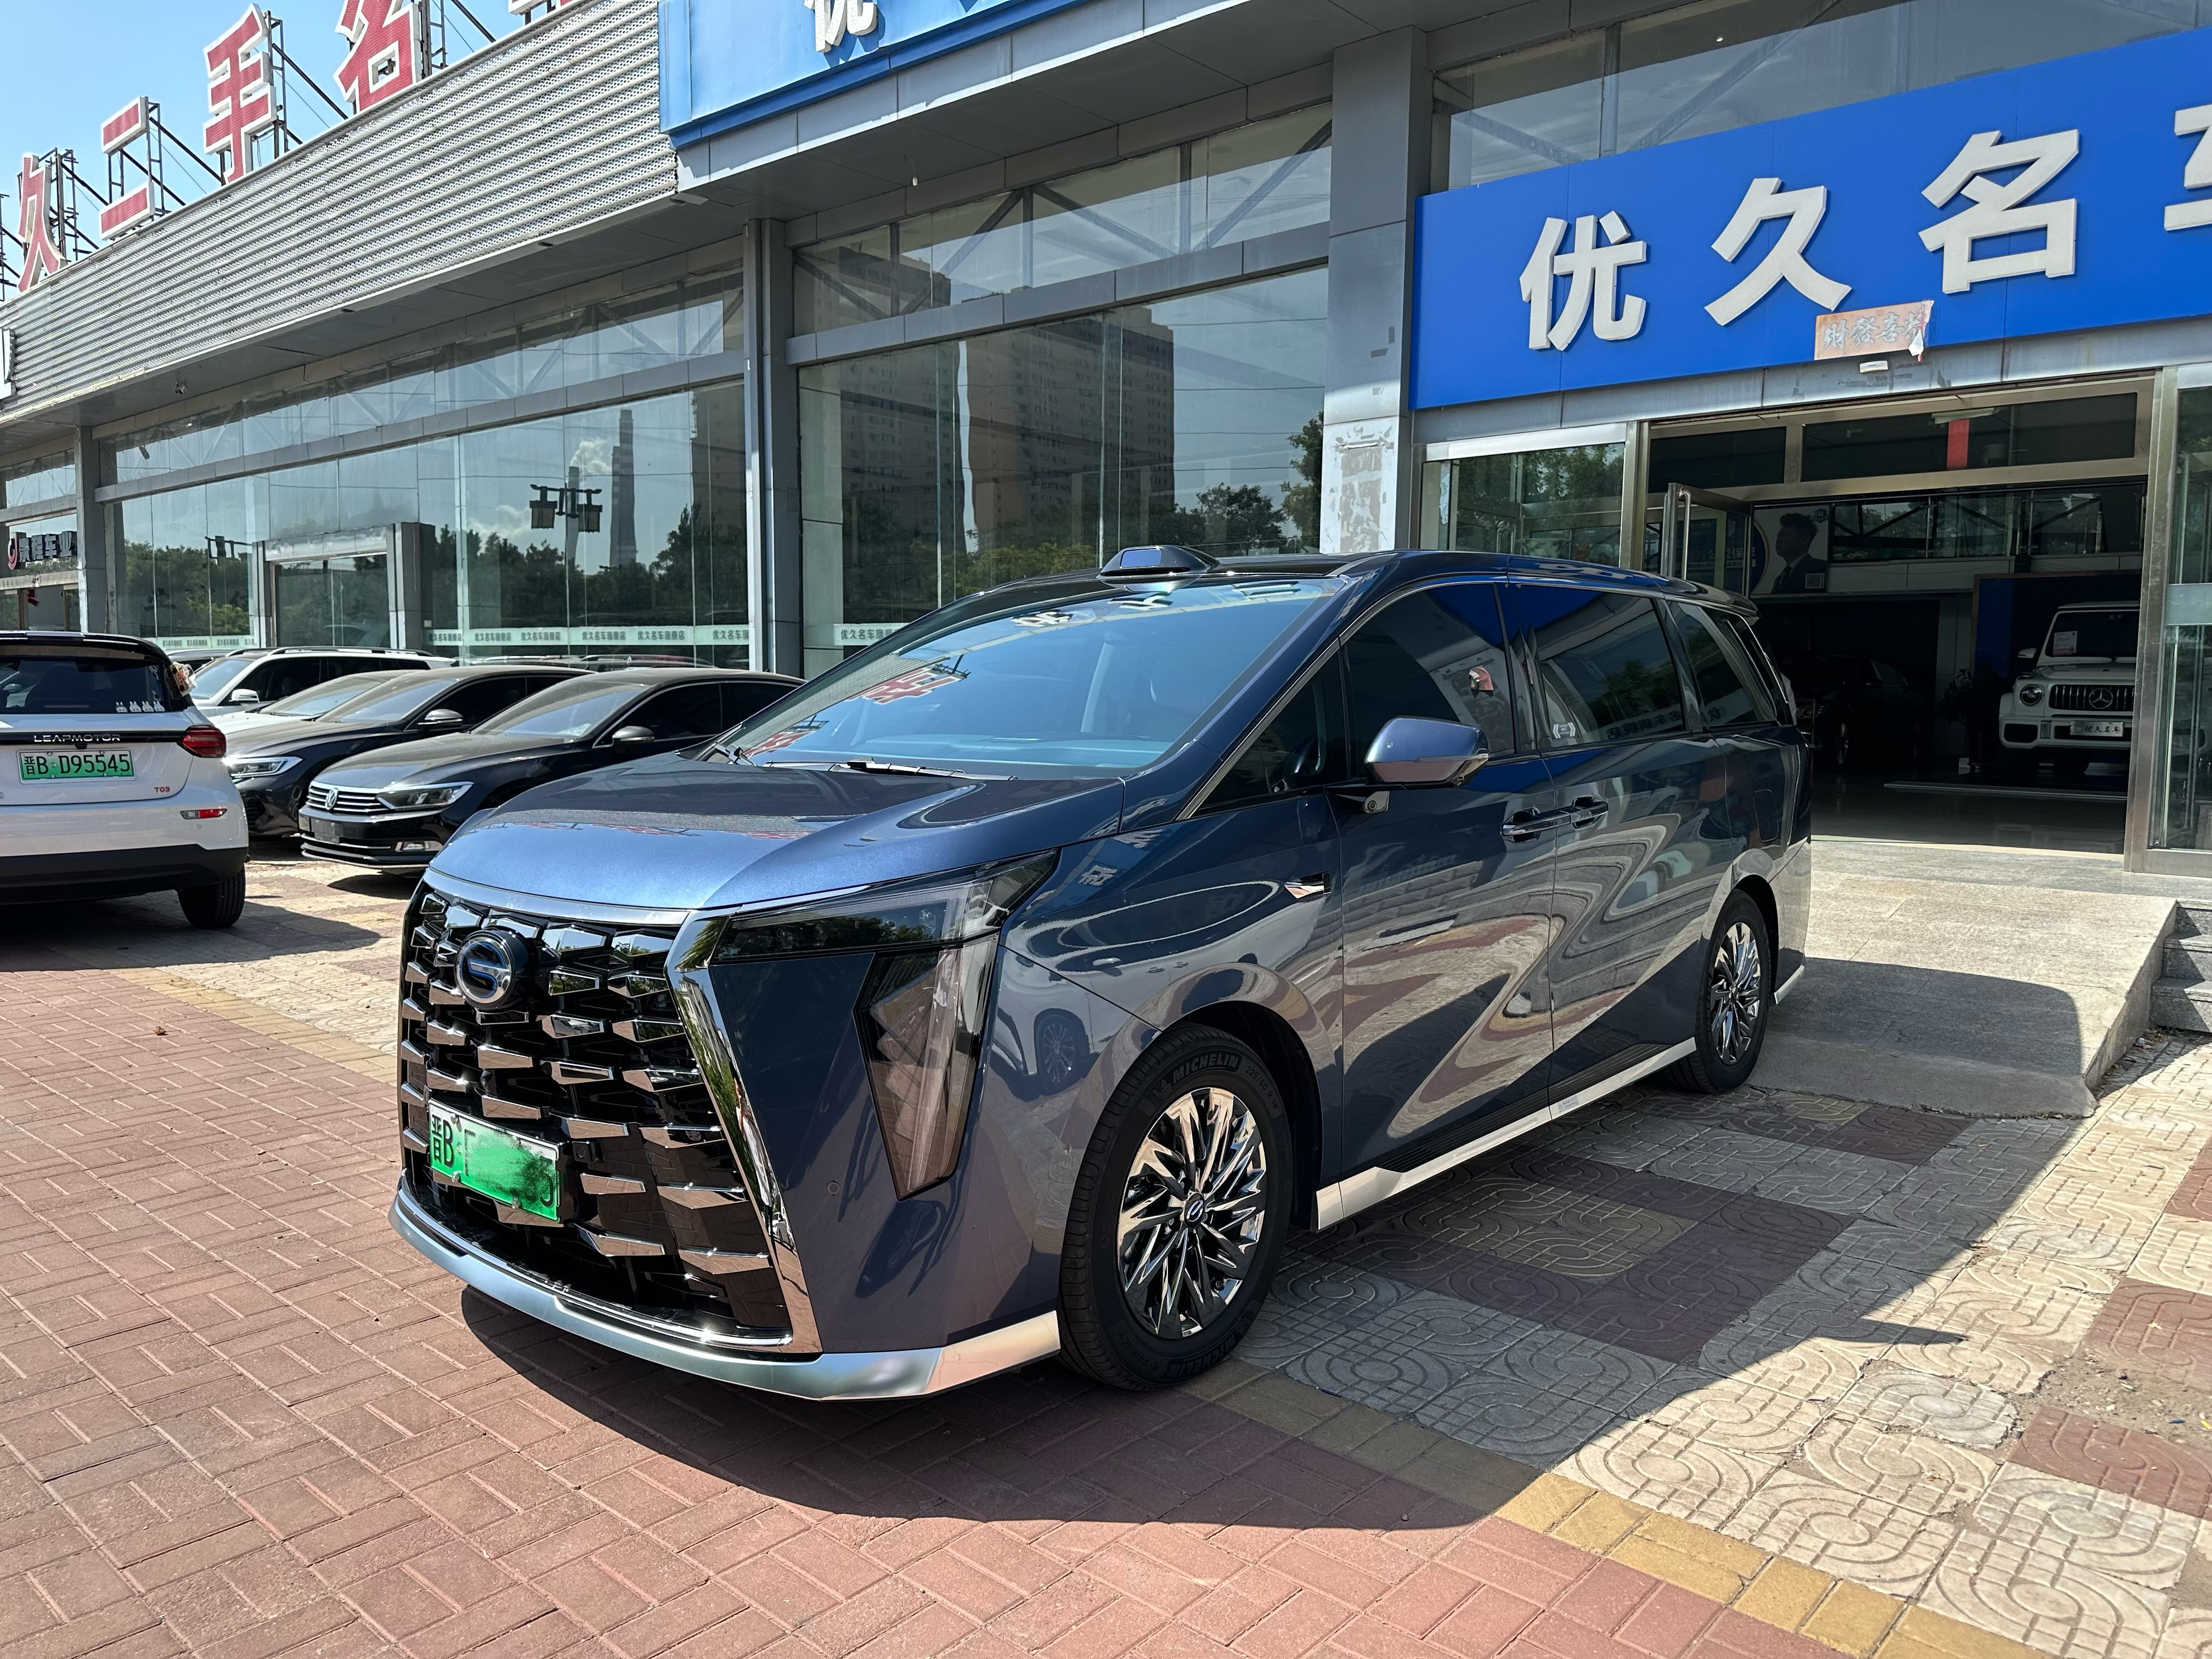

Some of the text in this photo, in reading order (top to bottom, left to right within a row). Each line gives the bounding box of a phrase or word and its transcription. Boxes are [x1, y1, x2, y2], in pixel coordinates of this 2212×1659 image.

[840, 629, 900, 640] 优久名车旗
[33, 733, 120, 742] LEAPMOTOR
[1172, 1053, 1239, 1085] MICHELIN
